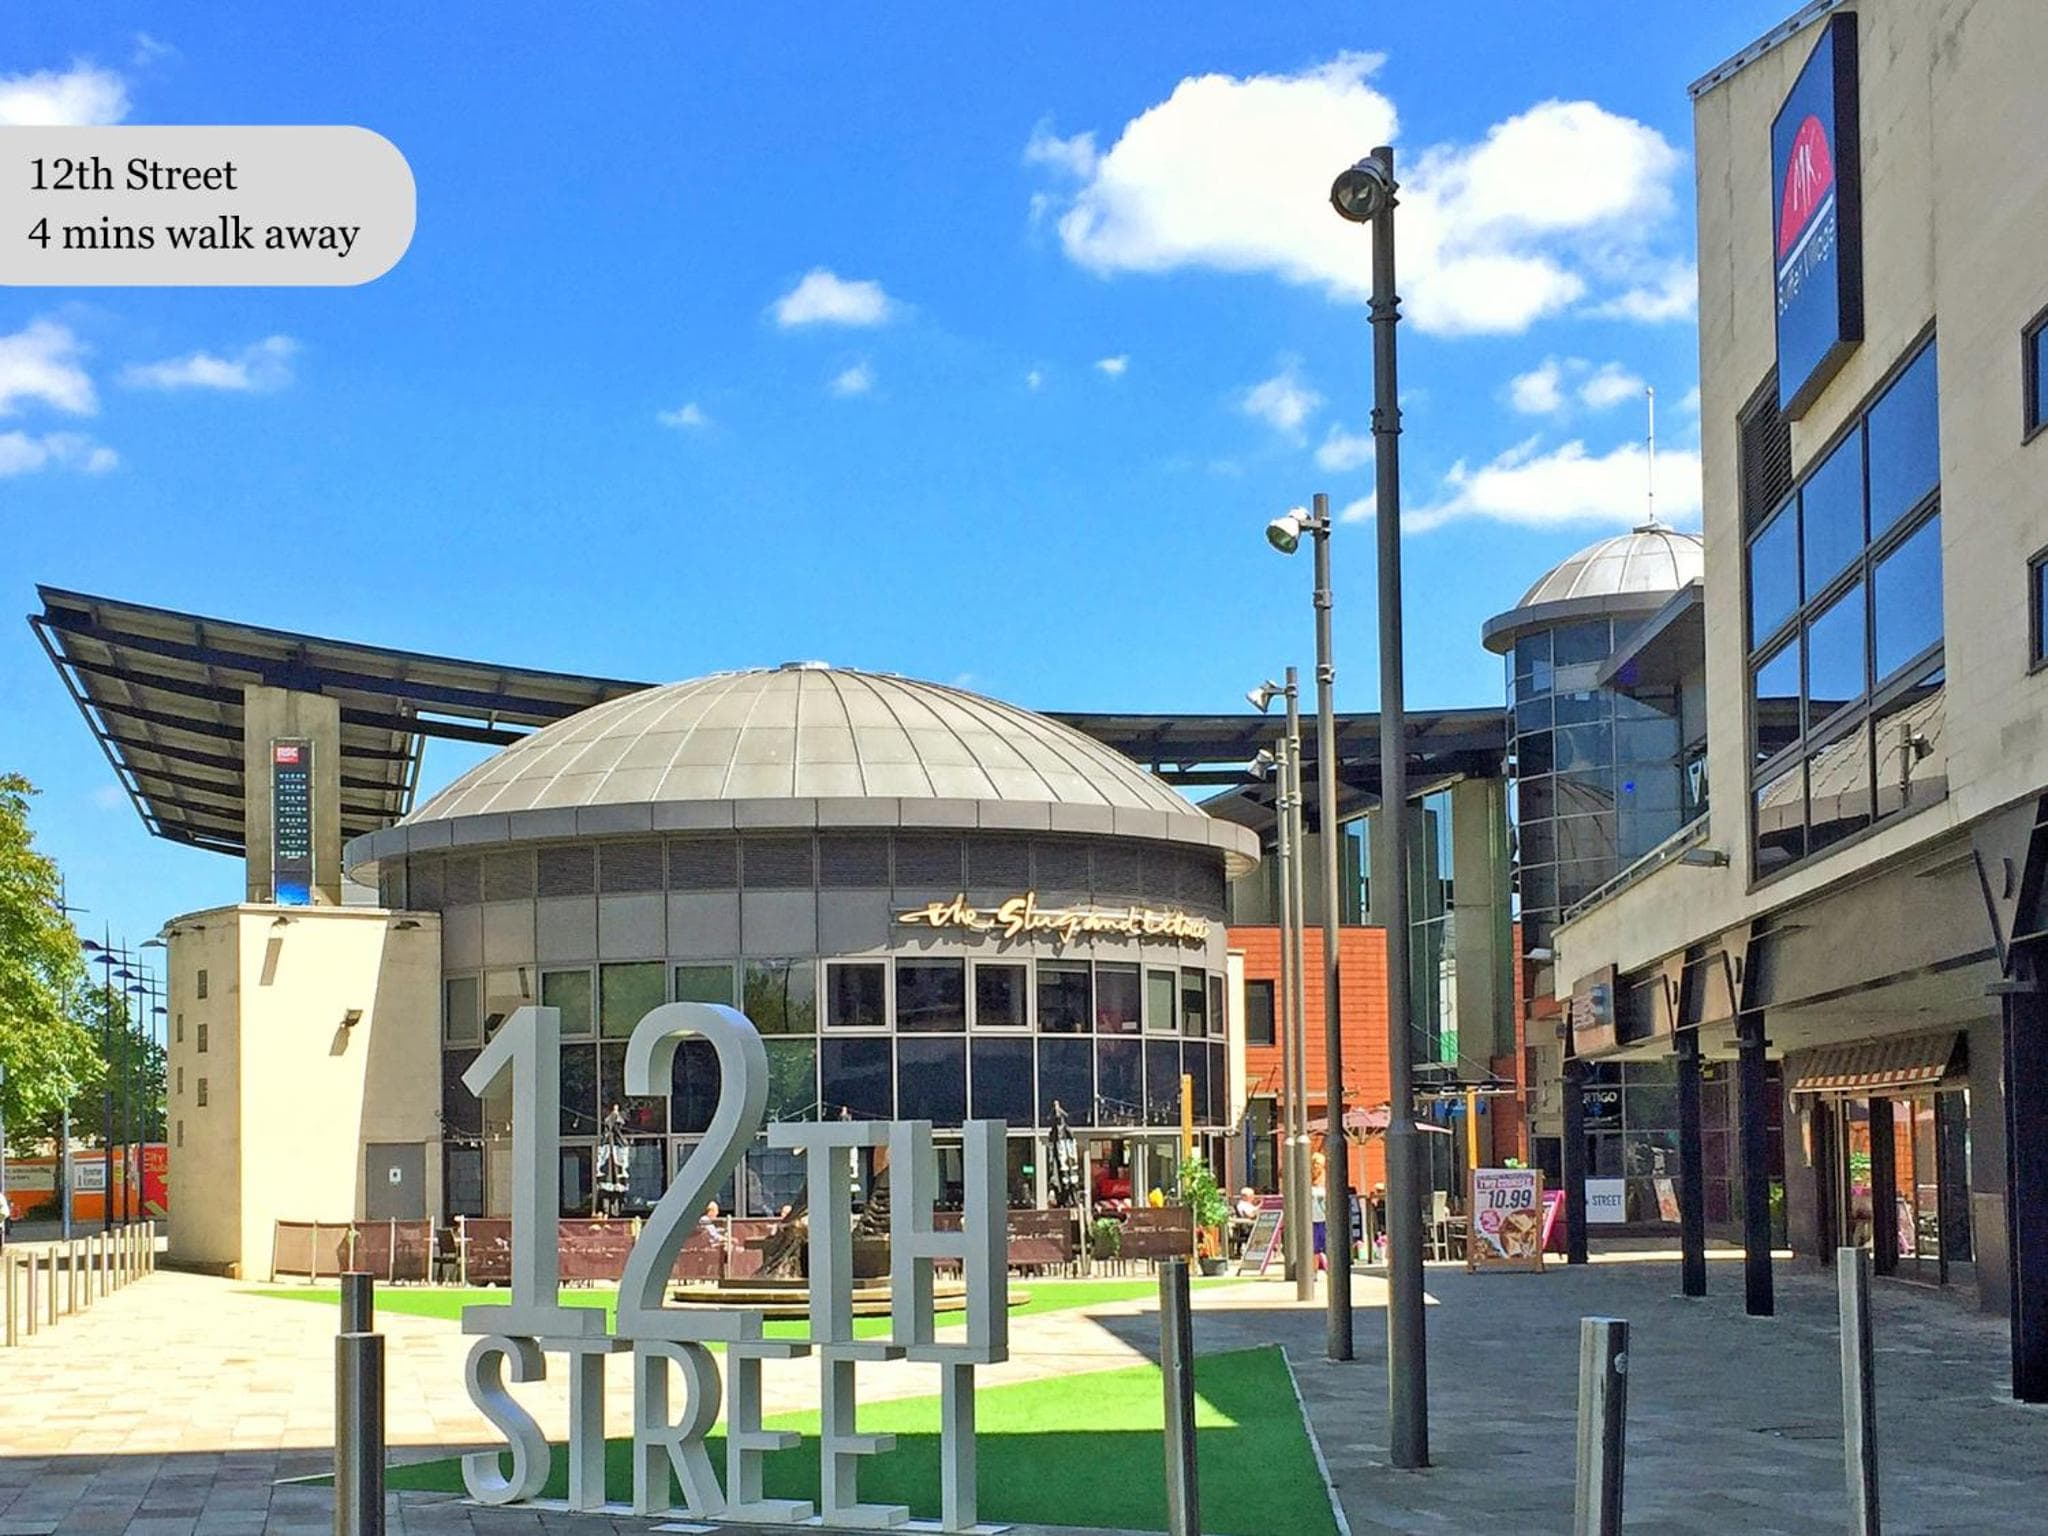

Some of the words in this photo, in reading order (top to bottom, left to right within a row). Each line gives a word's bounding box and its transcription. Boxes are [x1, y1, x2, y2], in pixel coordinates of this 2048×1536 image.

[998, 892, 1081, 943] Slug
[461, 1001, 1008, 1348] 12TH
[1489, 1189, 1531, 1209] 10.99
[461, 1336, 1008, 1532] STREET
